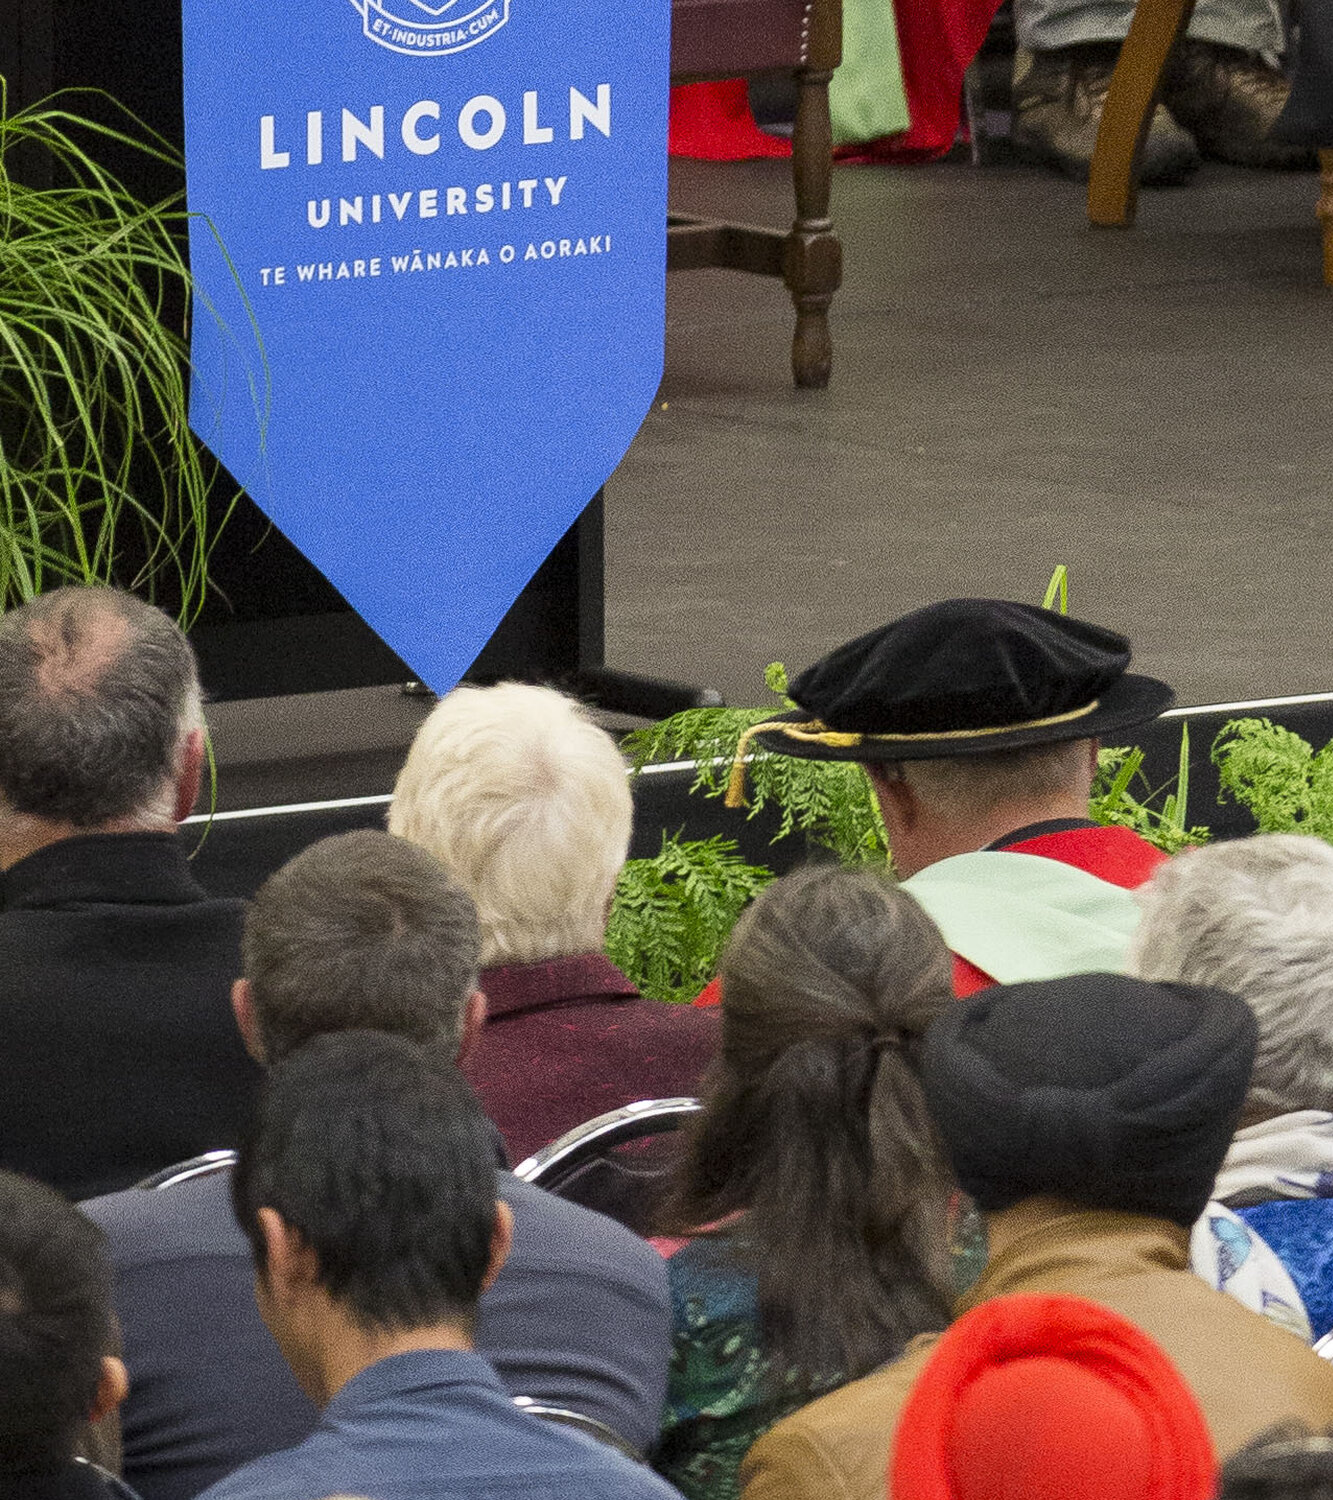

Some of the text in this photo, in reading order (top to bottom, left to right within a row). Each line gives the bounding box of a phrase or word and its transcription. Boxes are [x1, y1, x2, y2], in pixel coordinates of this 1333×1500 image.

[260, 84, 611, 169] LINCOLN
[307, 176, 568, 228] UNIVERSITY
[260, 235, 611, 286] TE WHARE WĀNAKA O AORAKI
